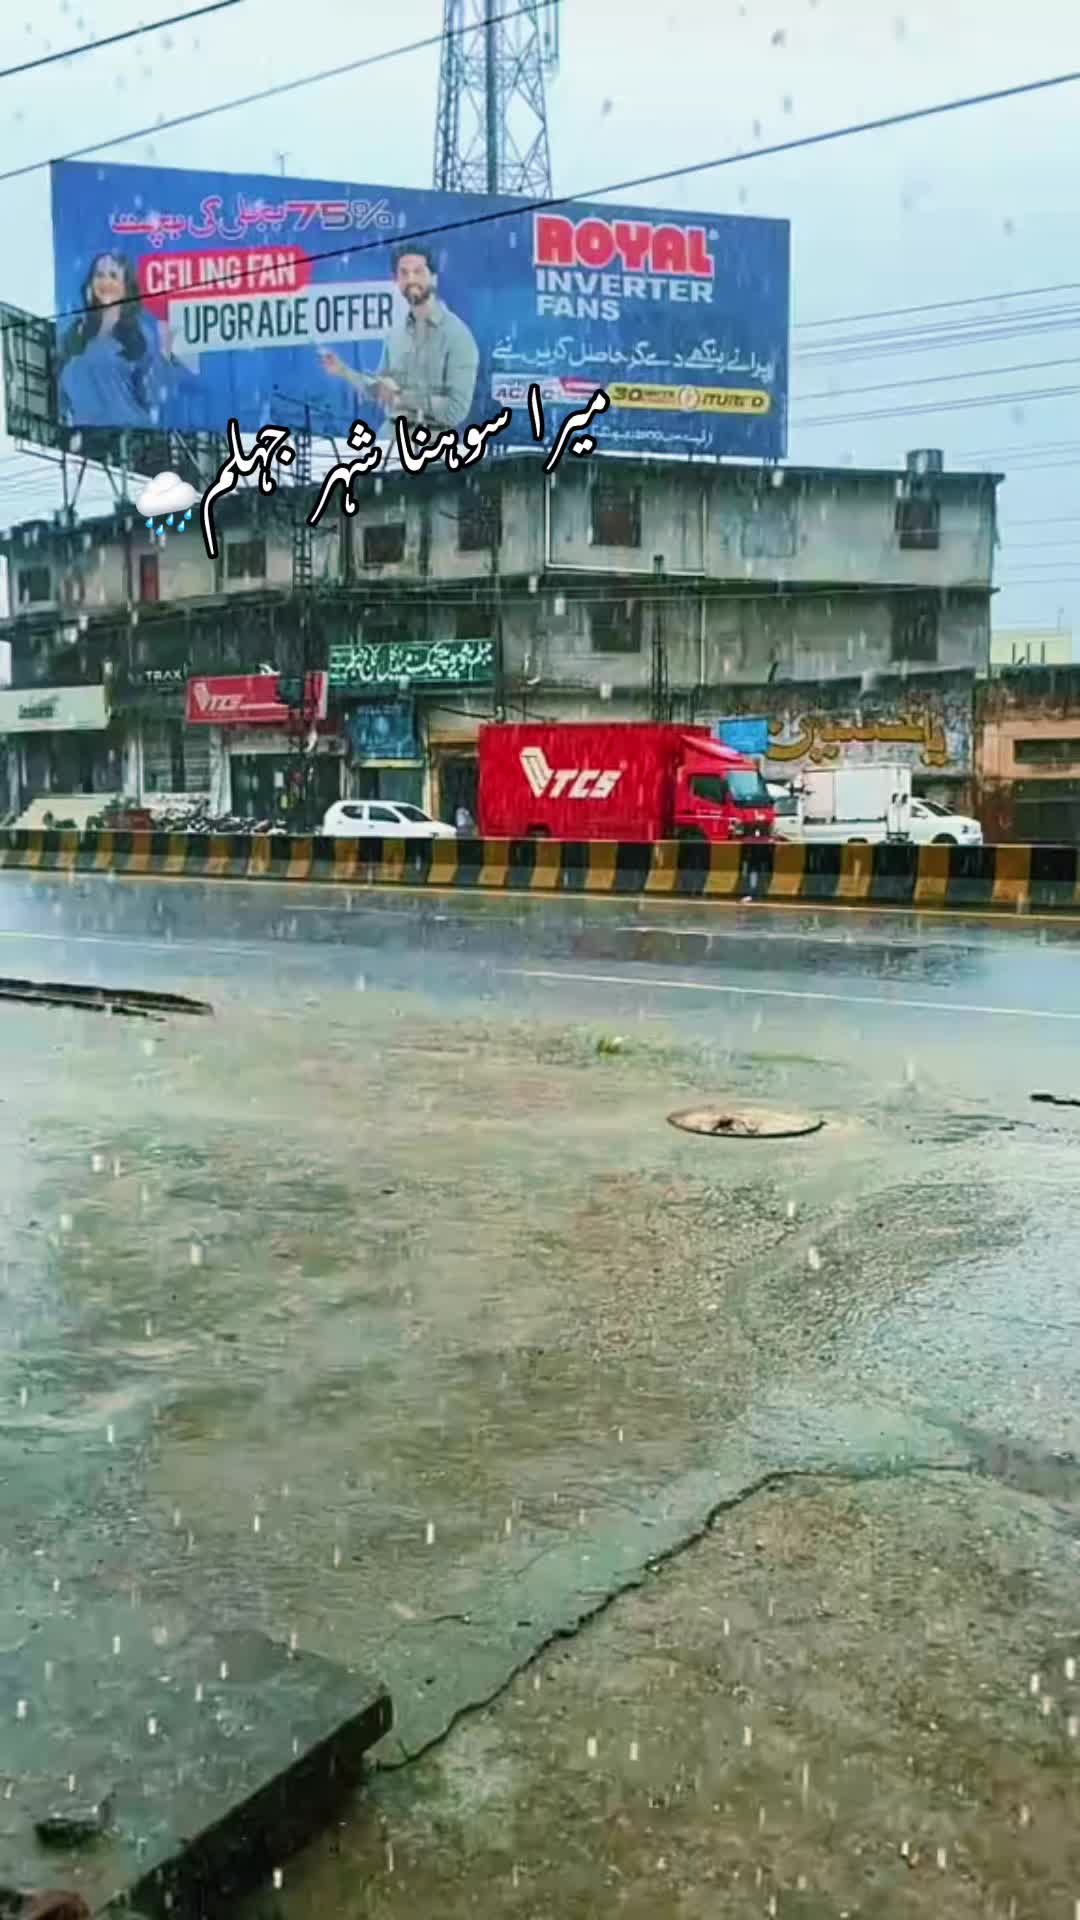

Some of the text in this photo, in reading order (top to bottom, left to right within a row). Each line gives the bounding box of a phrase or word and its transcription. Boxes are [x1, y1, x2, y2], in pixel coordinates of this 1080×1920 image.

[187, 195, 222, 239] کی
[284, 198, 393, 232] 75%
[533, 212, 714, 278] ROYAL
[145, 251, 297, 294] CEILING FAN
[536, 268, 713, 303] INVERTER
[183, 292, 394, 345] UPGRADE OFFER
[536, 295, 621, 322] FANS
[572, 338, 628, 367] حاصل
[495, 385, 554, 401] AC/C
[145, 669, 182, 681] TRAX
[549, 768, 622, 801] TCS
